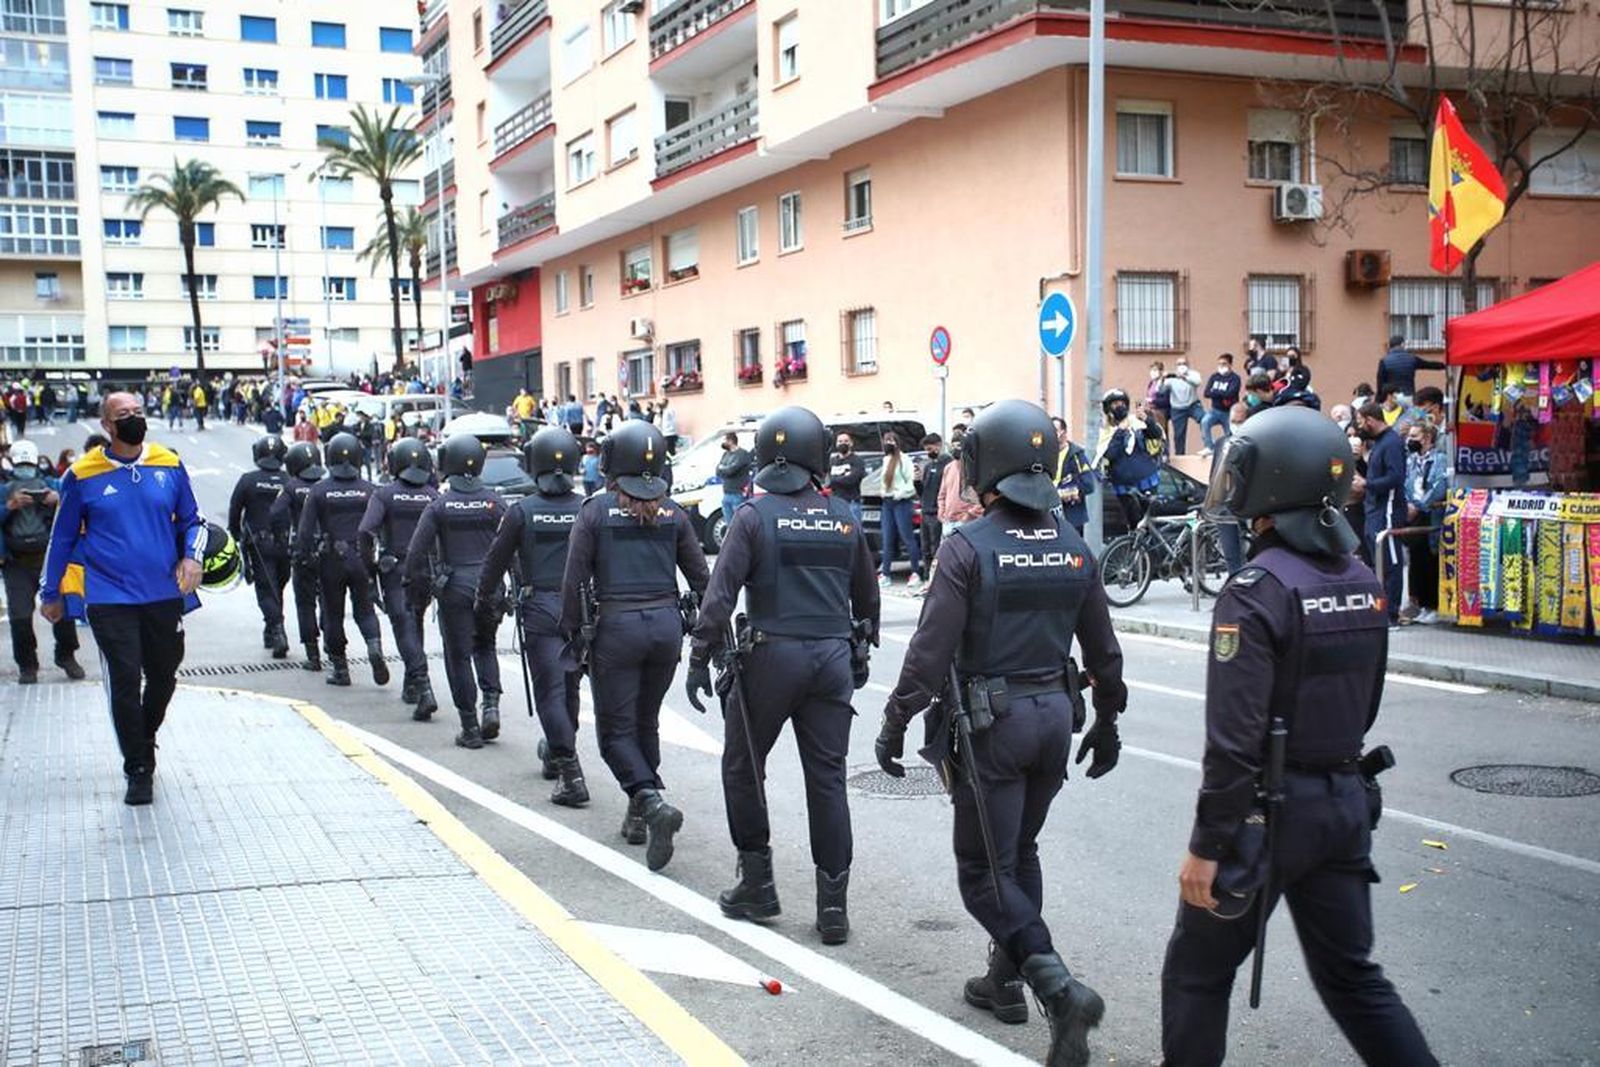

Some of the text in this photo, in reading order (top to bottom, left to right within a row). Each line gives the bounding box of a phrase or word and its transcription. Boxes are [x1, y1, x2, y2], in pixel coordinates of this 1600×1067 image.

[326, 489, 361, 498] POLICIA
[445, 501, 488, 509] POLICIA
[1507, 499, 1545, 511] MADRID
[777, 518, 843, 532] POLICIA
[999, 552, 1072, 567] POLICIA
[1302, 593, 1376, 615] POLICIA
